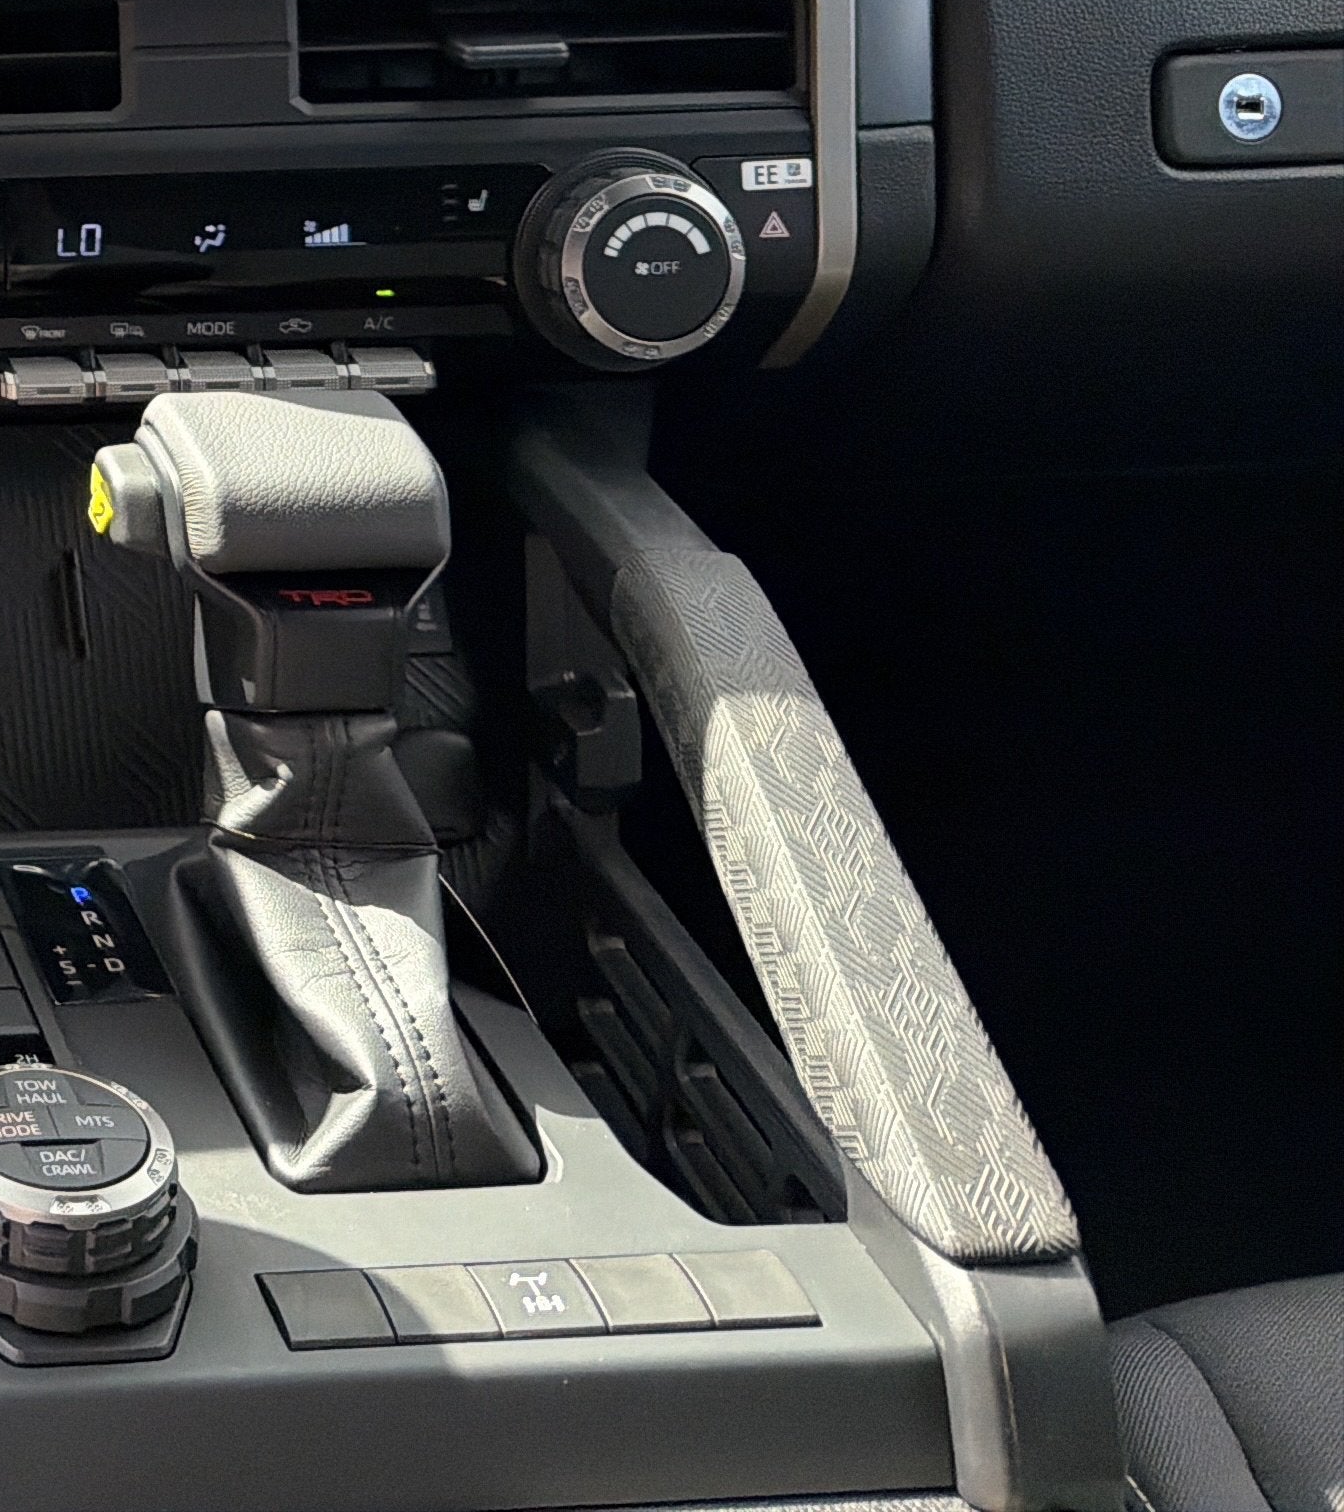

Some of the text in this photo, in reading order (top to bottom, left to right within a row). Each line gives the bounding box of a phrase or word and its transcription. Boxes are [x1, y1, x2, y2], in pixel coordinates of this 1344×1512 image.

[754, 164, 779, 185] EE
[58, 223, 102, 258] LO
[650, 261, 681, 275] OFF
[188, 320, 236, 337] MODE
[363, 315, 395, 332] A/C
[278, 588, 375, 607] TRD
[71, 886, 91, 905] P
[82, 909, 104, 925] R
[93, 933, 115, 949] N
[60, 957, 126, 976] S D
[14, 1053, 40, 1065] 2H
[14, 1080, 58, 1091] TOW
[16, 1093, 68, 1105] HAUL
[75, 1116, 116, 1129] MTS
[39, 1149, 86, 1163] DAC/
[42, 1164, 98, 1176] CRAWL
